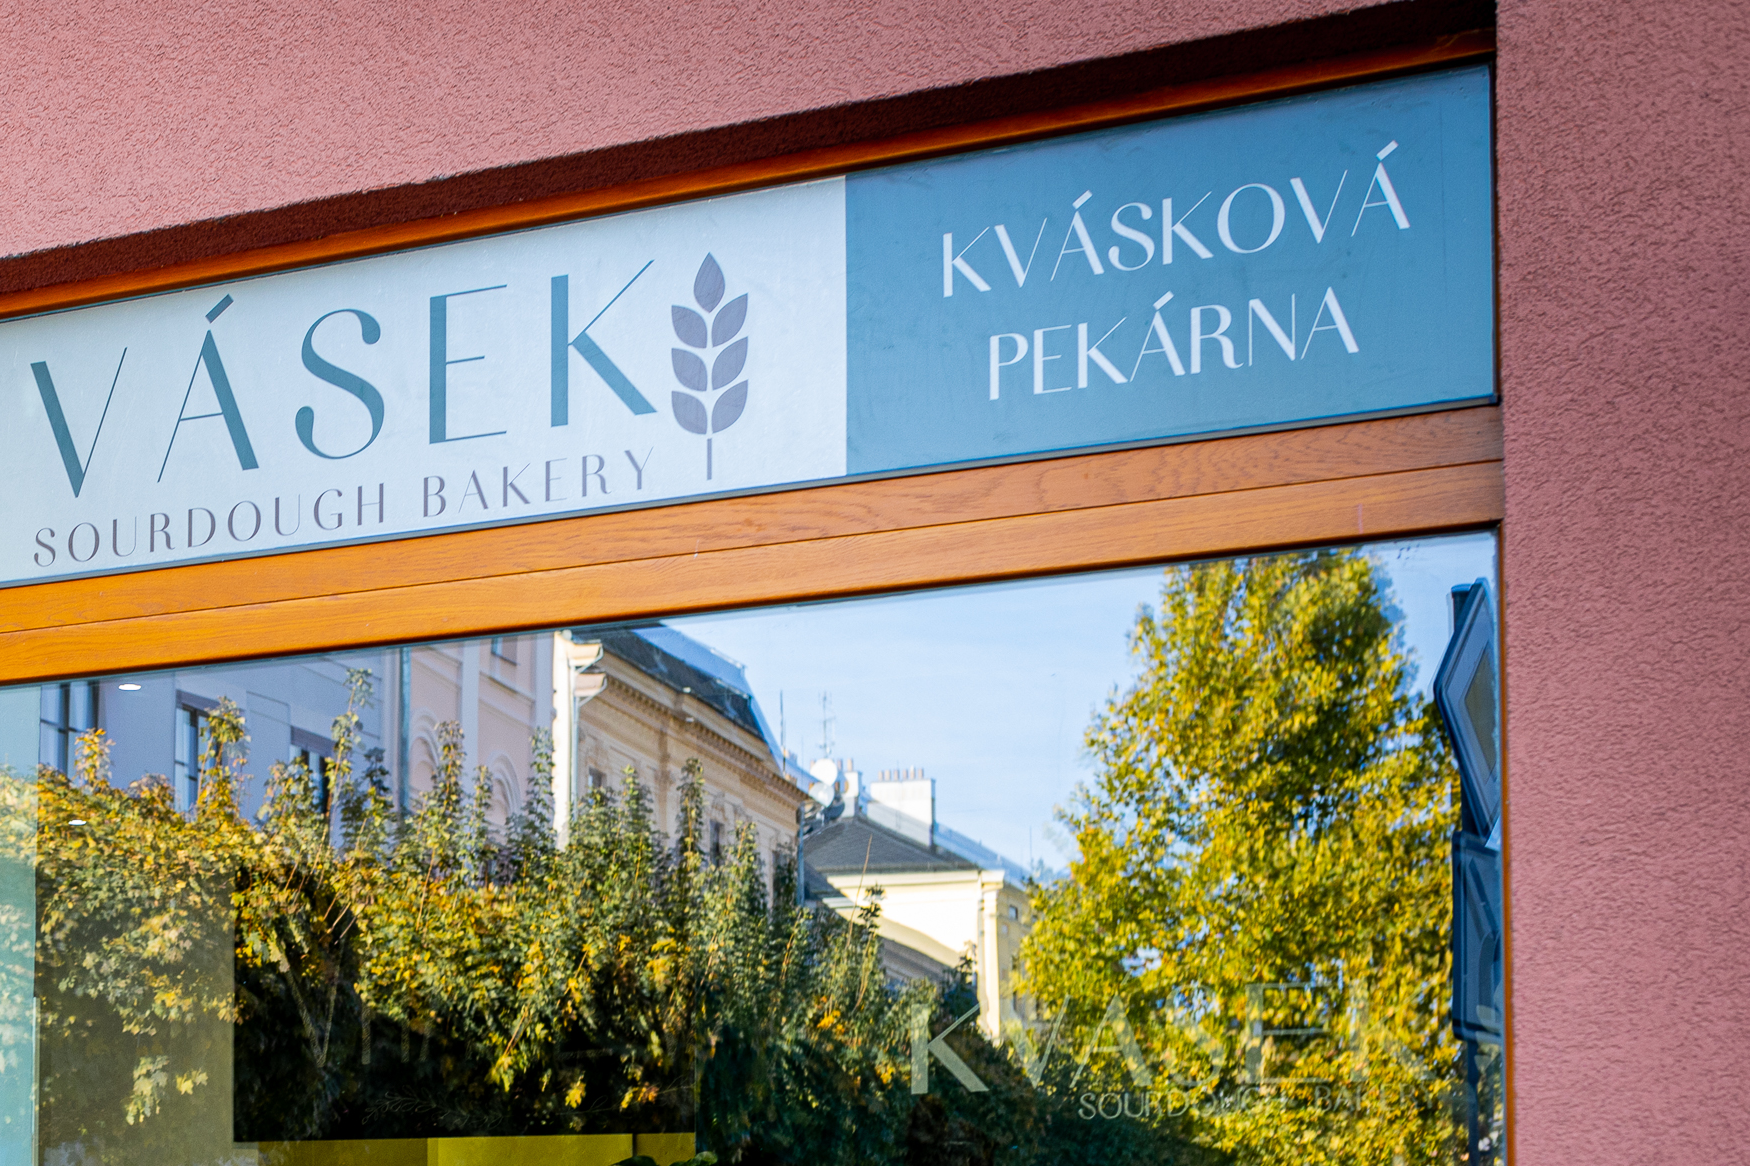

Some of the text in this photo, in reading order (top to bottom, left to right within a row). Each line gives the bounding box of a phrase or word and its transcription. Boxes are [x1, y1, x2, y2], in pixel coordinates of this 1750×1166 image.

[942, 139, 1411, 298] KVÁSKOVÁ
[988, 285, 1360, 401] PEKÁRNA
[33, 445, 655, 568] SOURDOUGH BAKERY
